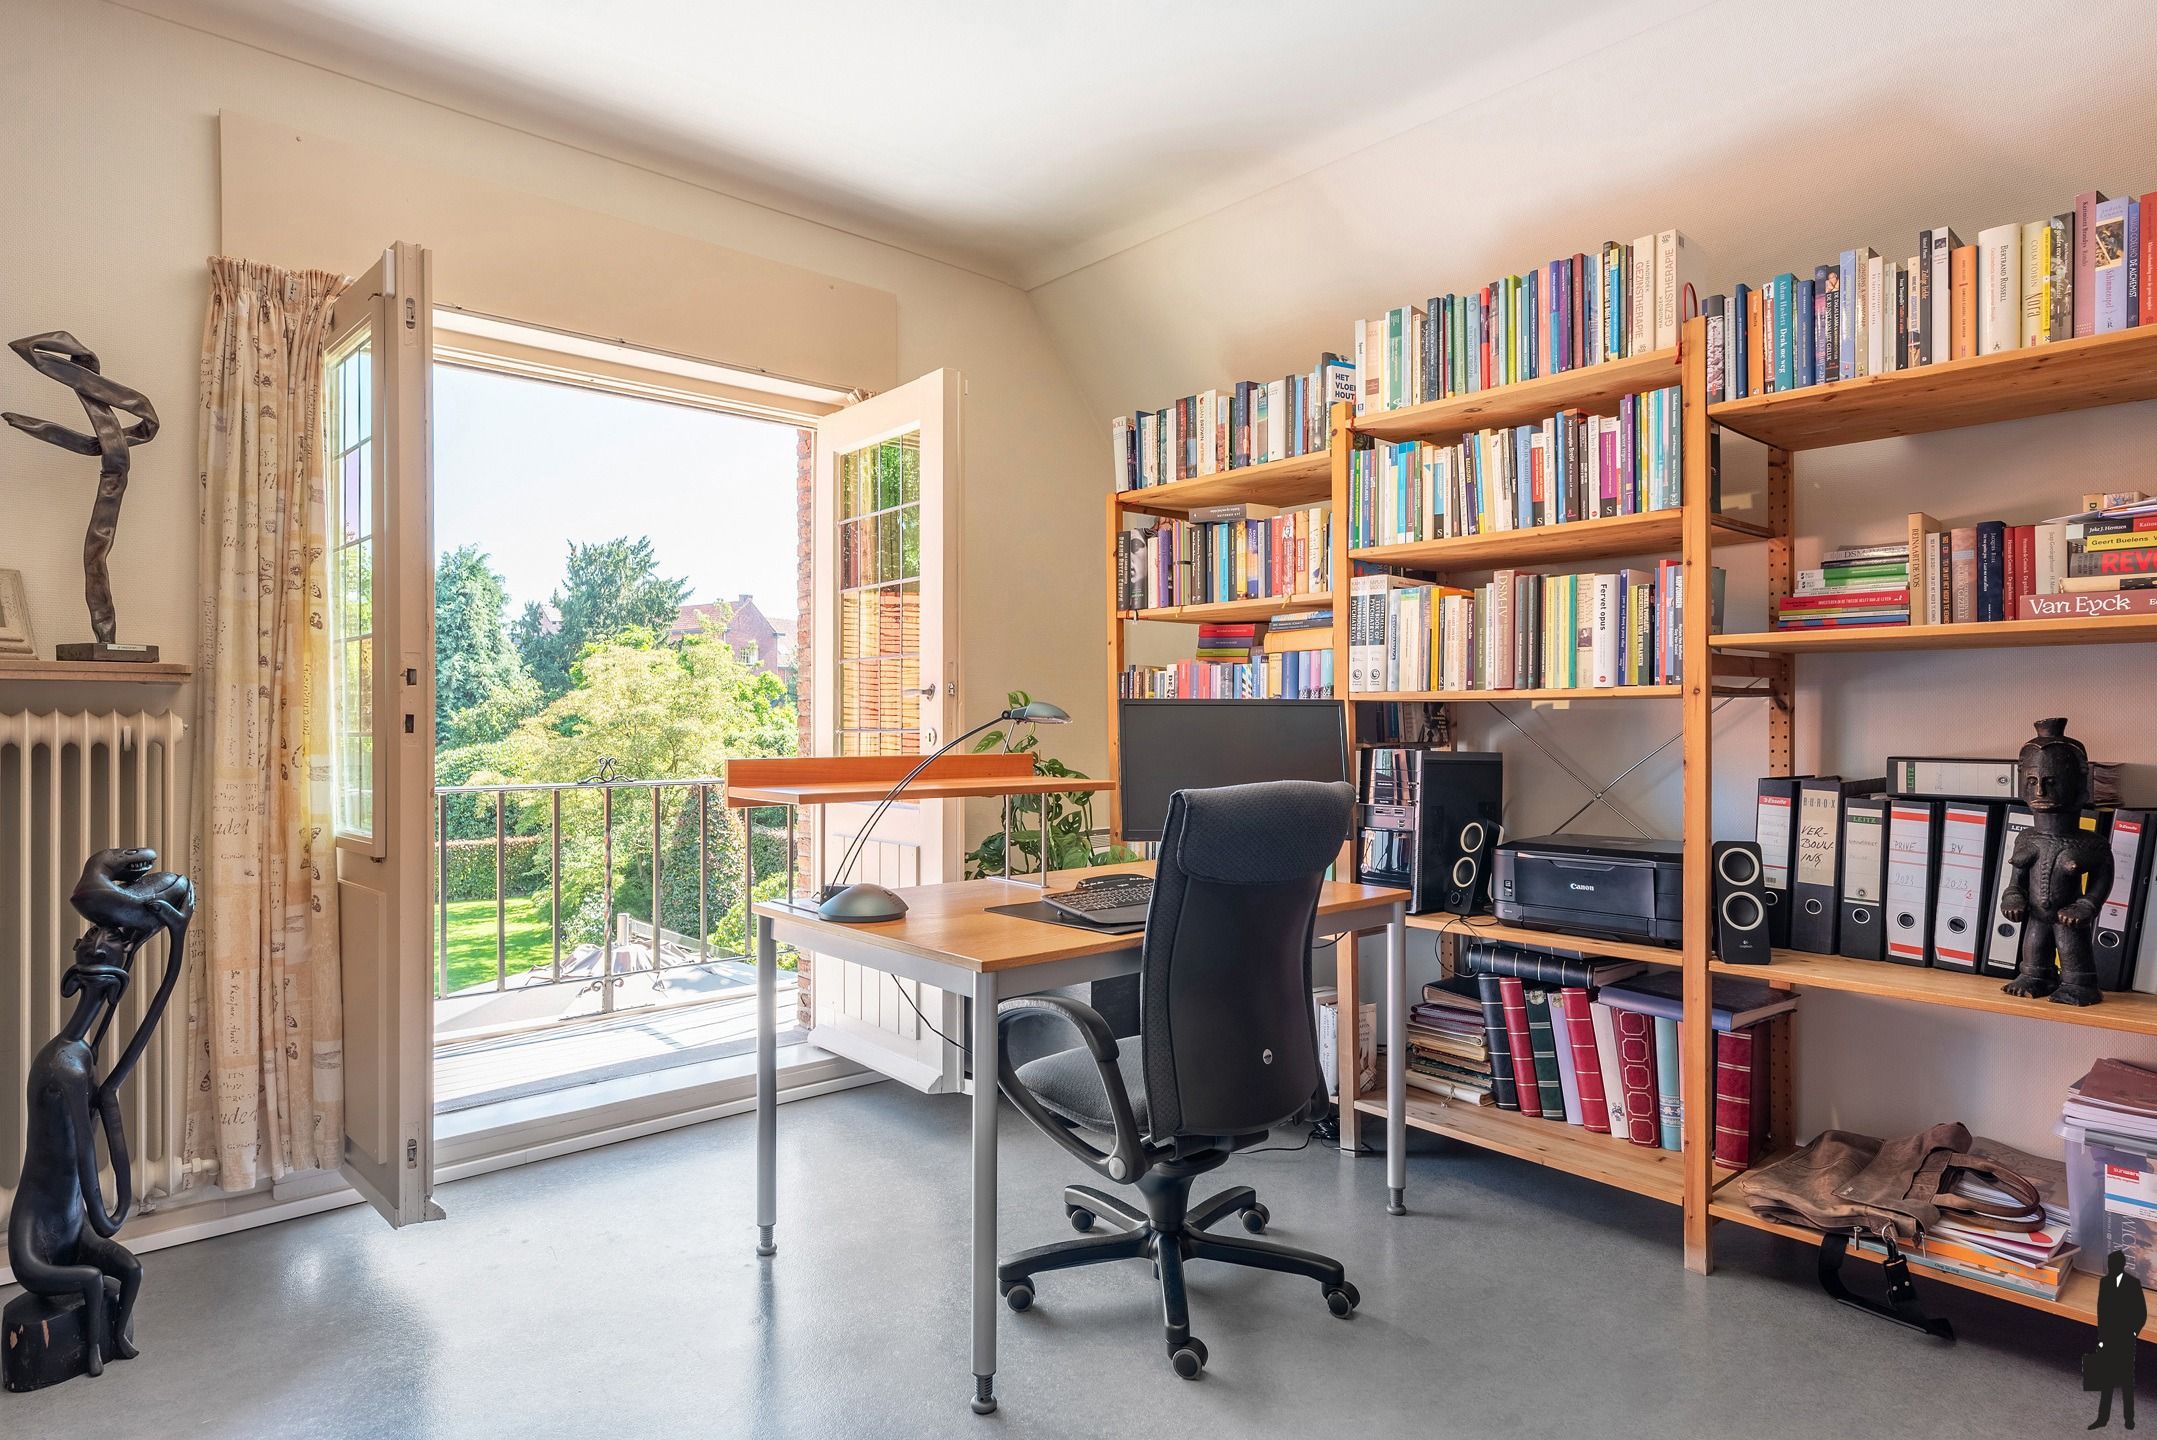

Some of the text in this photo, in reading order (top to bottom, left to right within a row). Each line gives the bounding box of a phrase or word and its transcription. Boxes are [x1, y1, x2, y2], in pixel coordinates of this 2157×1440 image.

[2000, 245, 2008, 302] BERTRAND RUSSELL
[1664, 248, 1673, 327] GEZINSTHERAPIE
[1635, 262, 1644, 338] GEZINSTHERAPIE
[2025, 292, 2043, 318] Nora
[1780, 349, 1787, 358] me
[1336, 373, 1349, 381] HET
[1498, 576, 1507, 617] DSM-IV
[1598, 584, 1608, 631] Fervet opus
[2029, 595, 2131, 616] Van Eyck
[1801, 826, 1828, 837] VER-
[1801, 839, 1834, 850] BOUW-
[1801, 853, 1822, 867] ING
[1570, 883, 1595, 892] Canon
[1945, 879, 1968, 889] 2023
